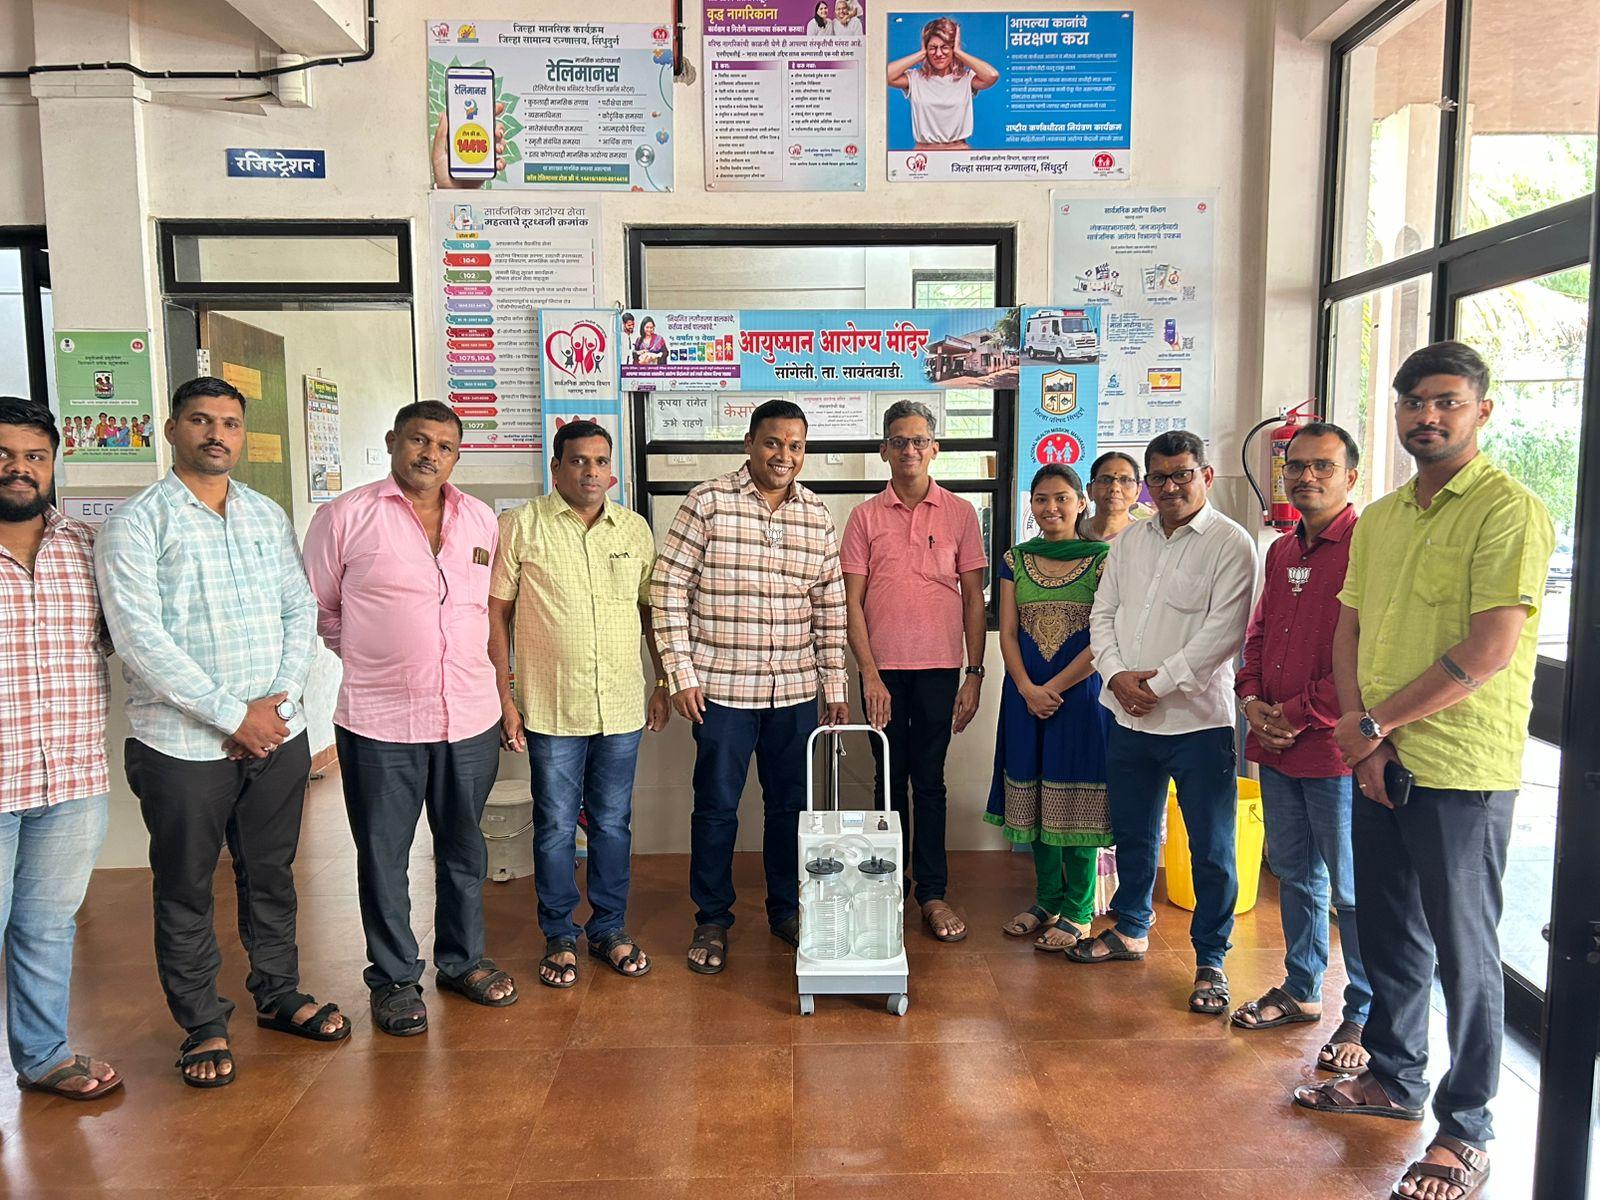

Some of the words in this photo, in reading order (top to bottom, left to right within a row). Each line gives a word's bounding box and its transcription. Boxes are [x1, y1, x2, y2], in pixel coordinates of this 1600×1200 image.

[727, 4, 778, 20] नागरिकांना
[513, 23, 535, 34] जिल्हा
[539, 23, 570, 33] मानसिक
[573, 23, 604, 34] कार्यक्रम
[1010, 18, 1049, 29] आपल्या
[1053, 15, 1088, 29] कानांचे
[498, 34, 520, 45] जिल्हा
[523, 36, 550, 45] सामान्य
[1010, 29, 1057, 46] संरक्षण
[1061, 31, 1089, 46] करा
[546, 58, 620, 82] टेलिमानस
[454, 84, 487, 95] टेलिमानस
[235, 151, 315, 177] रजिस्ट्रेशन
[951, 163, 973, 173] जिल्हा
[975, 164, 1001, 173] सामान्य
[1041, 162, 1068, 174] सिंधुदुर्ग
[484, 207, 531, 216] सार्वजनिक
[533, 207, 565, 216] आरोग्य
[567, 207, 585, 216] सेवा
[557, 218, 589, 227] क्रमांक
[739, 331, 814, 363] आयुष्मान
[820, 322, 882, 353] आरोग्य
[886, 322, 929, 357] मंदिर
[775, 362, 817, 379] सांगेली,
[822, 366, 838, 379] ता.
[842, 362, 903, 379] सावंतवाडी.
[657, 398, 681, 411] कृपया
[686, 396, 707, 407] रांगेत
[682, 418, 703, 428] राहणे
